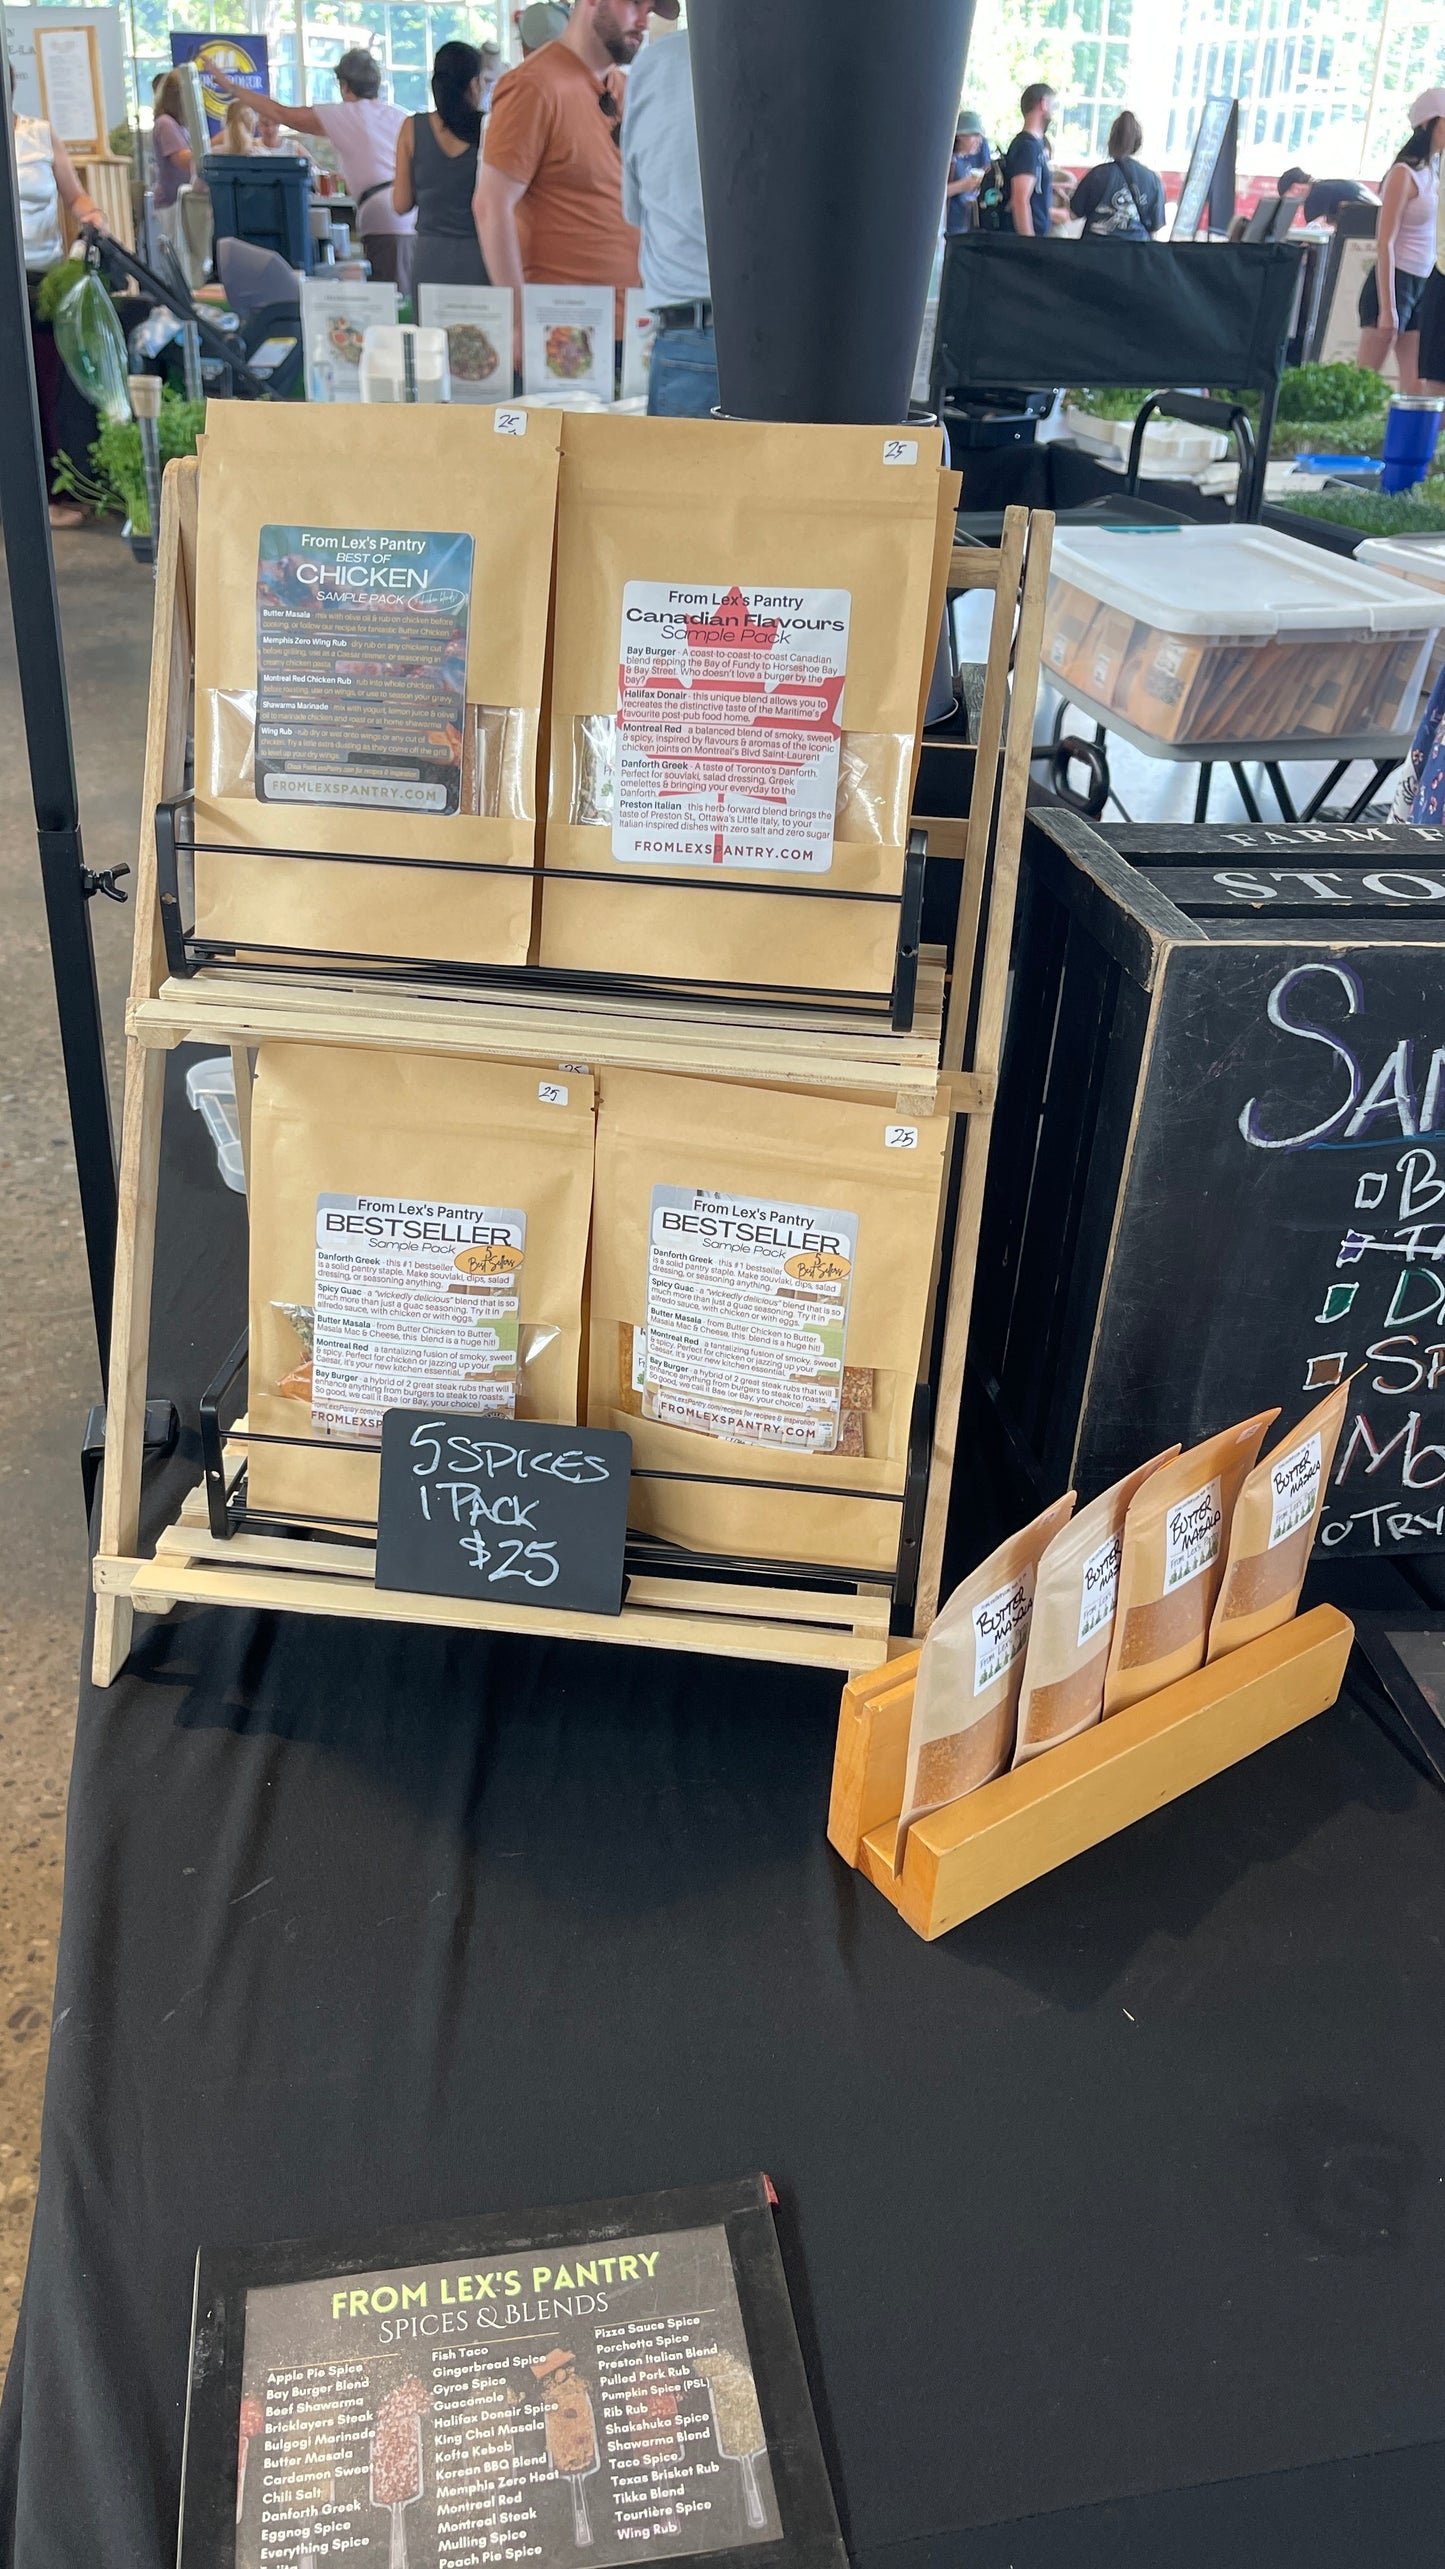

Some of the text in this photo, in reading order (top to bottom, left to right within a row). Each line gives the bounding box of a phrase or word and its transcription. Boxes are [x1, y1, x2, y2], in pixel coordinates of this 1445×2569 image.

[885, 441, 907, 459] 25
[301, 533, 426, 555] From Lex's Pantry
[336, 552, 392, 564] BEST OF
[297, 563, 428, 589] CHICKEN
[316, 590, 372, 605] SAMPLE
[369, 593, 405, 605] PACK
[669, 590, 804, 611] From Lex's Pantry
[626, 608, 844, 632] Canadian Flavours
[262, 636, 348, 648] Memphis Zero Wing Rub
[661, 625, 791, 646] Sample Pack
[626, 646, 676, 658] Bay Burger
[262, 700, 329, 710] Shawarma Marinade
[623, 700, 820, 718] recreates the distinctive taste of the Maritime's
[624, 689, 827, 709] Halifax Donair this unique blend allows you to
[261, 727, 293, 737] Wing Rub
[623, 723, 682, 734] Montreal Red
[621, 759, 689, 770] Danforth Greek
[273, 781, 437, 802] FROMLEXSPANTRY.COM
[619, 799, 682, 811] Preston Italian
[1221, 827, 1397, 847] FARM
[635, 841, 813, 860] FROMLEXSPANTRY.COM
[1213, 872, 1445, 900] STO
[538, 1086, 560, 1102] 25
[890, 1128, 914, 1147] 25
[1396, 1148, 1445, 1221] B
[358, 1199, 484, 1224] From Lex's Pantry
[694, 1199, 815, 1231] From Lex's Pantry
[326, 1213, 511, 1247] BESTSELLER
[662, 1212, 840, 1255] BESTSELLER
[368, 1237, 456, 1255] Sample Pack
[702, 1237, 786, 1259] Sample Pack
[318, 1251, 381, 1266] Danforth Greek
[317, 1283, 362, 1296] Spicy Guac
[1384, 1268, 1445, 1328] D
[317, 1314, 371, 1329] Butter Masala
[316, 1338, 369, 1352] Montreal Red
[315, 1369, 359, 1382] Bay Burger
[661, 1402, 815, 1439] FROMLEXSPANTRY.COM
[410, 1421, 610, 1484] 5 SPICES
[1273, 1450, 1311, 1495] BUTTER
[420, 1482, 540, 1531] 1 PACK
[1169, 1494, 1212, 1545] BUTTER
[1181, 1510, 1221, 1551] MASALA
[459, 1529, 560, 1587] $25
[1085, 1539, 1121, 1591] BUTTER
[1099, 1564, 1120, 1592] MAS
[976, 1586, 1026, 1637] BUTTER
[332, 2252, 658, 2319] FROM LEX'S PANTRY
[379, 2292, 608, 2343] SPICES & BLENDS
[594, 2317, 700, 2339] Pizza Sauce Spice
[596, 2334, 689, 2354] Porchetta Spice
[432, 2354, 547, 2378] Gingerbread Spice
[598, 2343, 718, 2371] Preston Italian Blend
[267, 2363, 363, 2386] Apple Pie Spice
[600, 2364, 691, 2387] Pulled Pork Rub
[266, 2376, 370, 2402] Bay Burger Blend
[265, 2397, 364, 2417] Beef Shawarma
[265, 2410, 374, 2434] Bricklayers Steak
[264, 2427, 376, 2453] Bulgogi Marinade
[263, 2448, 353, 2469] Butter Masala
[435, 2452, 547, 2481] Korean BBQ Blend
[263, 2462, 374, 2486] Cardamon Sweet
[262, 2486, 323, 2504] Chili Salt
[262, 2499, 361, 2523] Danforth Greek
[614, 2500, 712, 2522] Tourtière Spice
[261, 2521, 351, 2543] Eggnog Spice
[260, 2536, 370, 2560] Everything Spice
